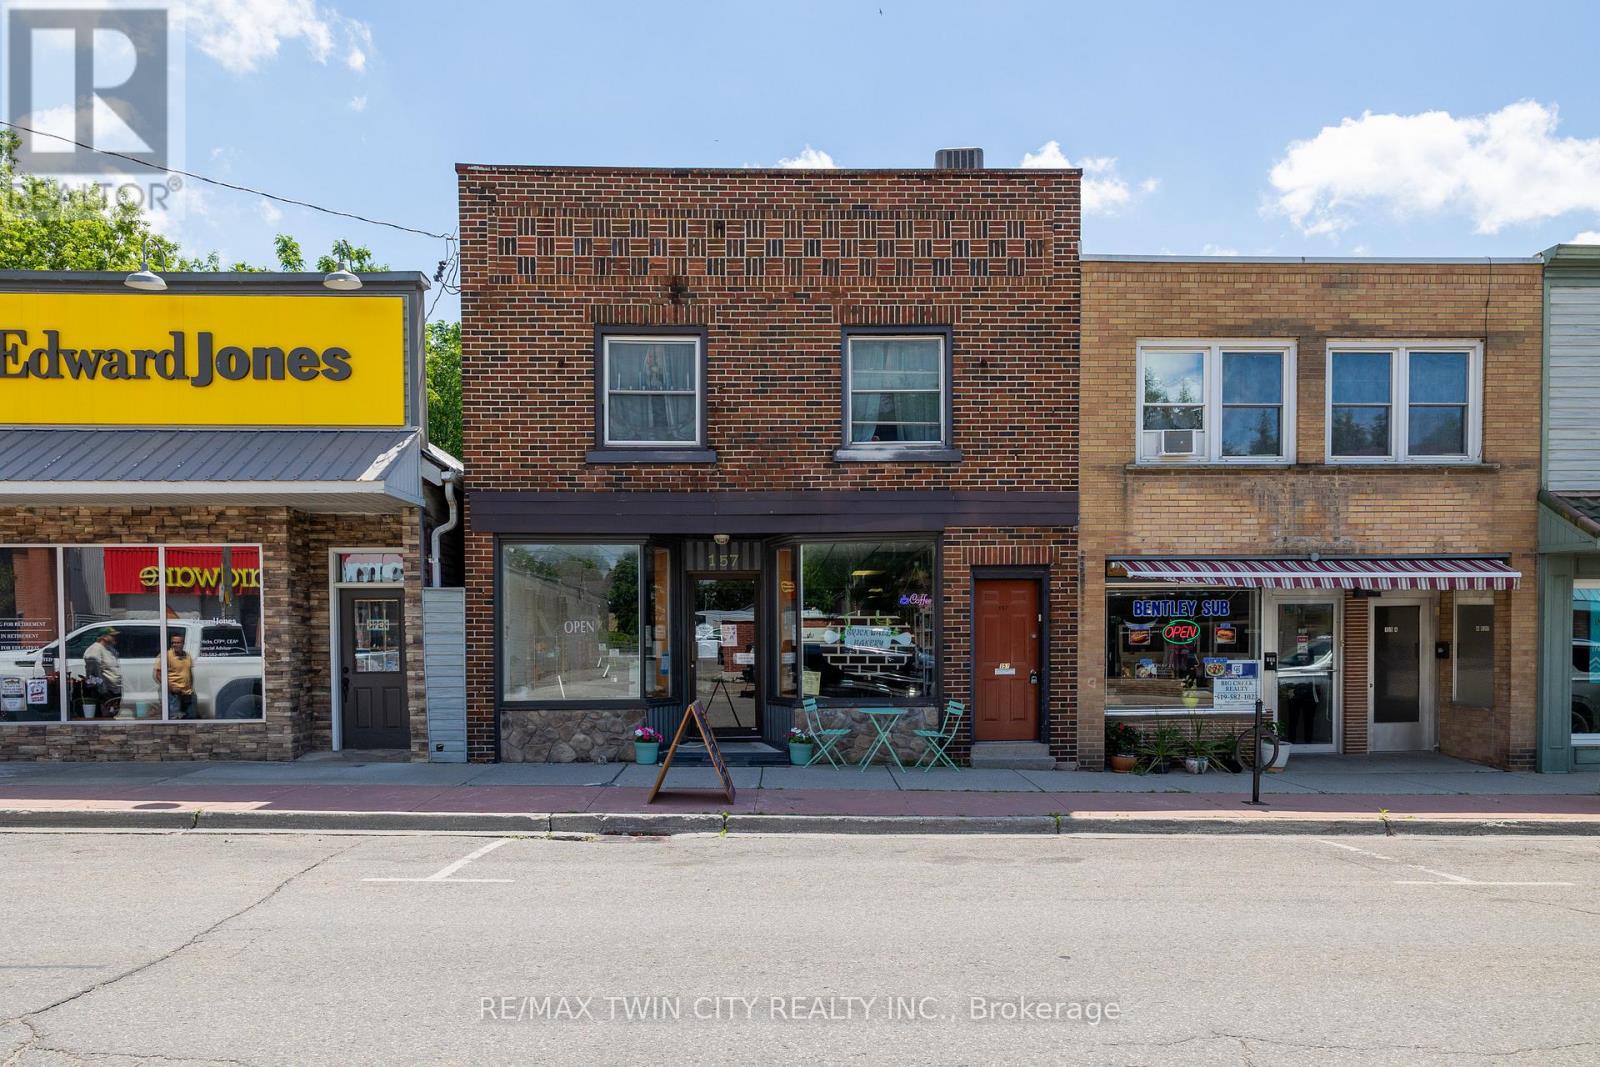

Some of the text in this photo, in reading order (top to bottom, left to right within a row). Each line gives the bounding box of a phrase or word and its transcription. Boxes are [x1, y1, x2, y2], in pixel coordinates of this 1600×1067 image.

[0, 329, 352, 387] Edward Jones
[708, 554, 739, 567] 157
[1133, 599, 1230, 617] BENTLEY SUB
[564, 620, 595, 634] OPEN
[1164, 625, 1197, 639] OPEN
